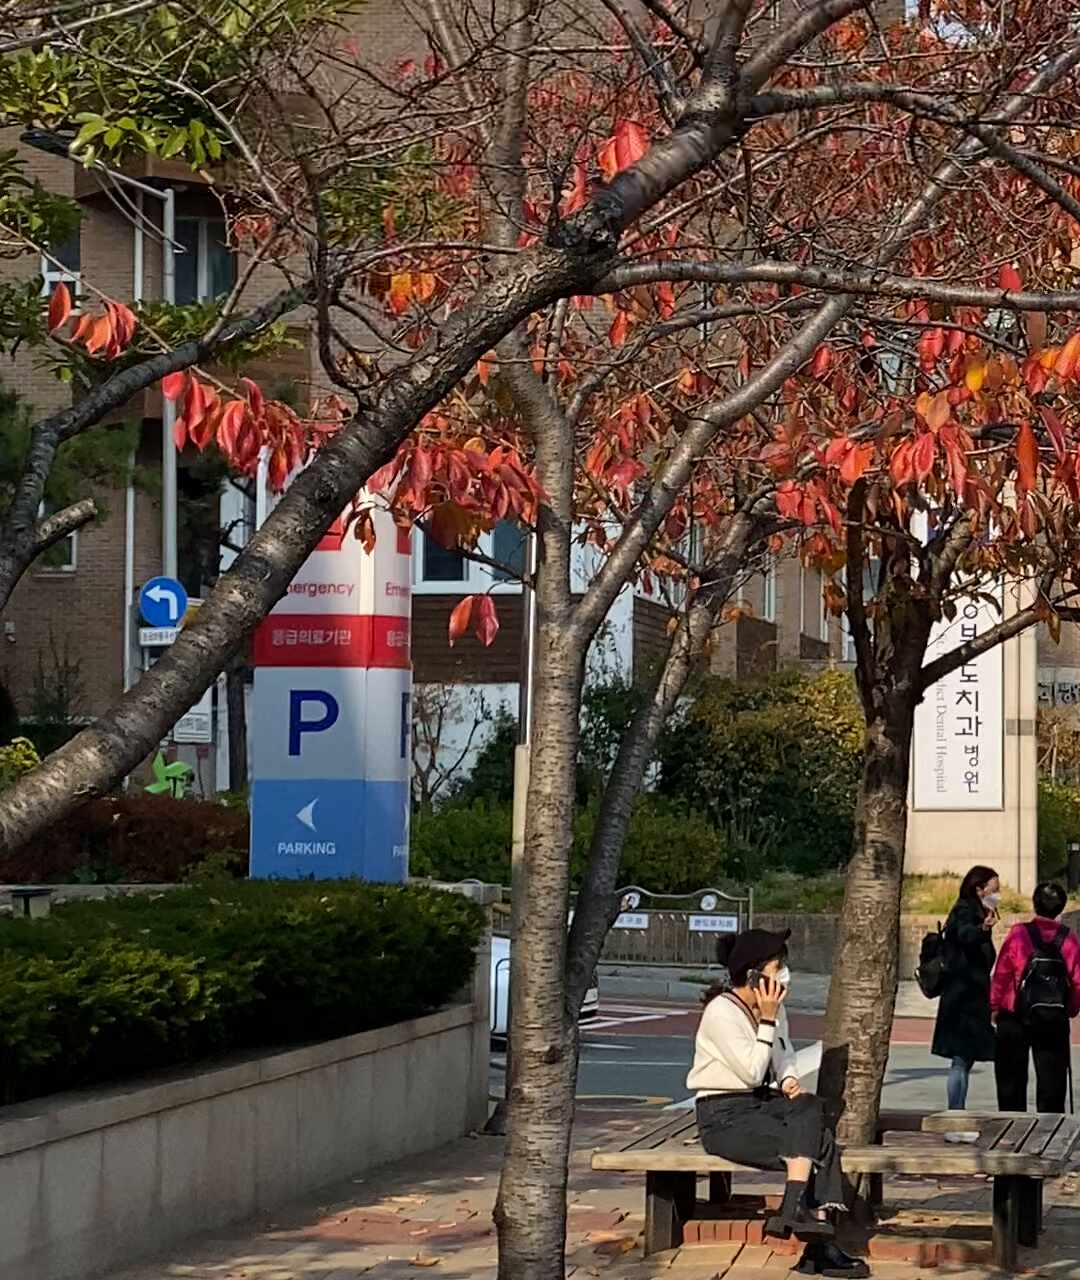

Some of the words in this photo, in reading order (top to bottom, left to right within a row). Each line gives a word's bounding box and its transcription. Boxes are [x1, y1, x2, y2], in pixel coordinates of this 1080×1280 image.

[287, 582, 354, 597] ergency
[272, 628, 352, 646] 응급의료기관
[288, 689, 339, 756] P
[936, 705, 947, 742] Dental
[934, 745, 948, 793] Hospital
[278, 841, 337, 855] PARKING
